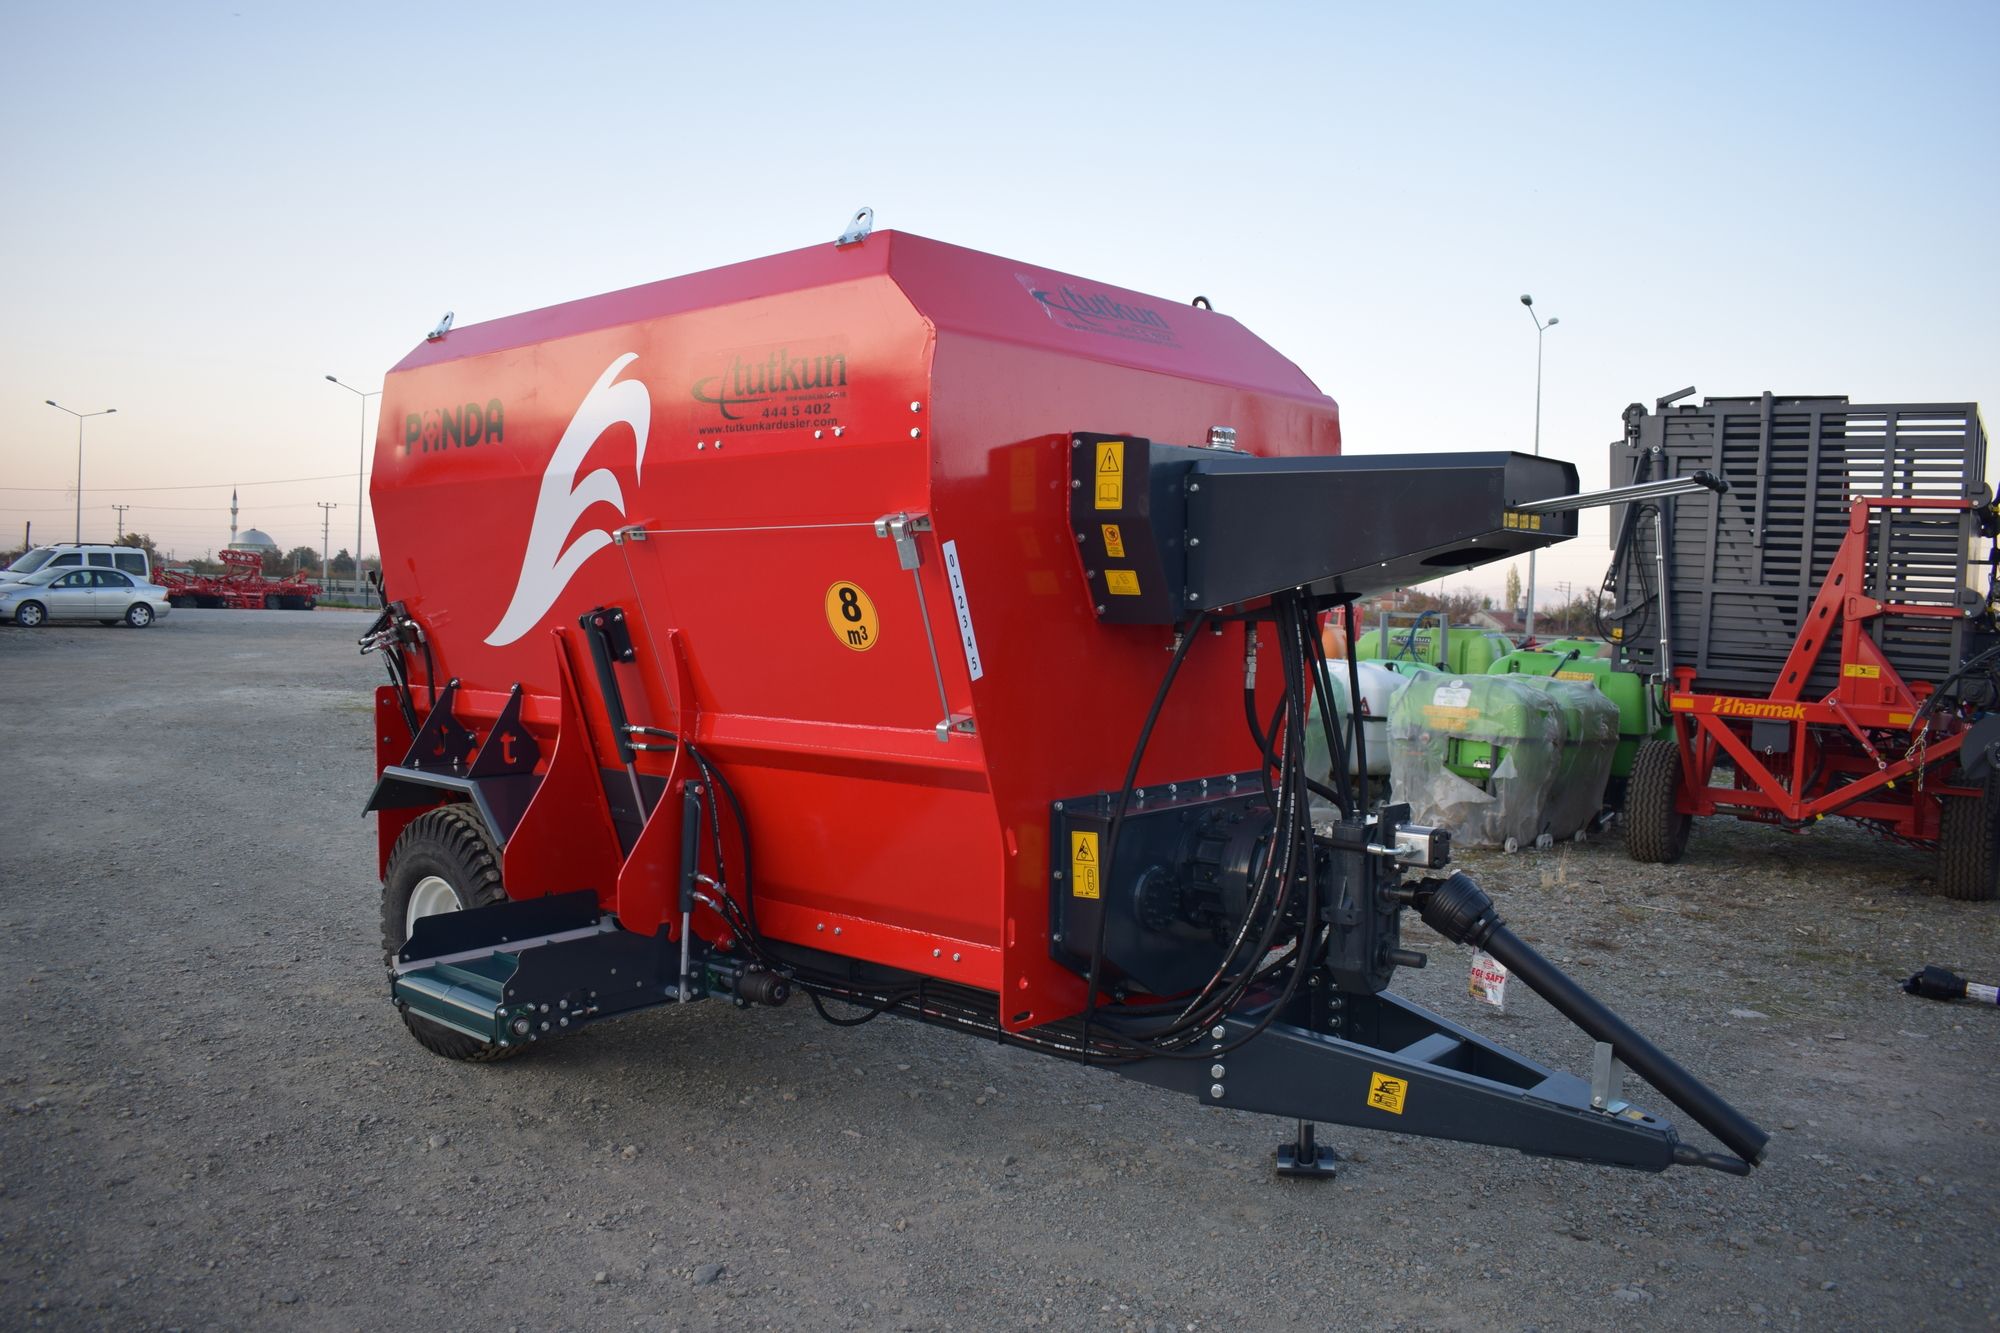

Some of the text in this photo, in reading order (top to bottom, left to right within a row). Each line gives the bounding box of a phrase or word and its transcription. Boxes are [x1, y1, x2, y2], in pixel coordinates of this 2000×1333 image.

[732, 347, 848, 397] tutkun
[762, 403, 831, 418] 444 5 402
[405, 398, 504, 455] PANDA
[699, 417, 838, 436] www.tutkunkardesler.com
[949, 554, 955, 568] 0
[953, 575, 960, 589] 1
[839, 587, 861, 622] 8
[958, 596, 964, 609] 2
[962, 615, 968, 628] 3
[967, 636, 973, 649] 4
[971, 657, 978, 670] 5
